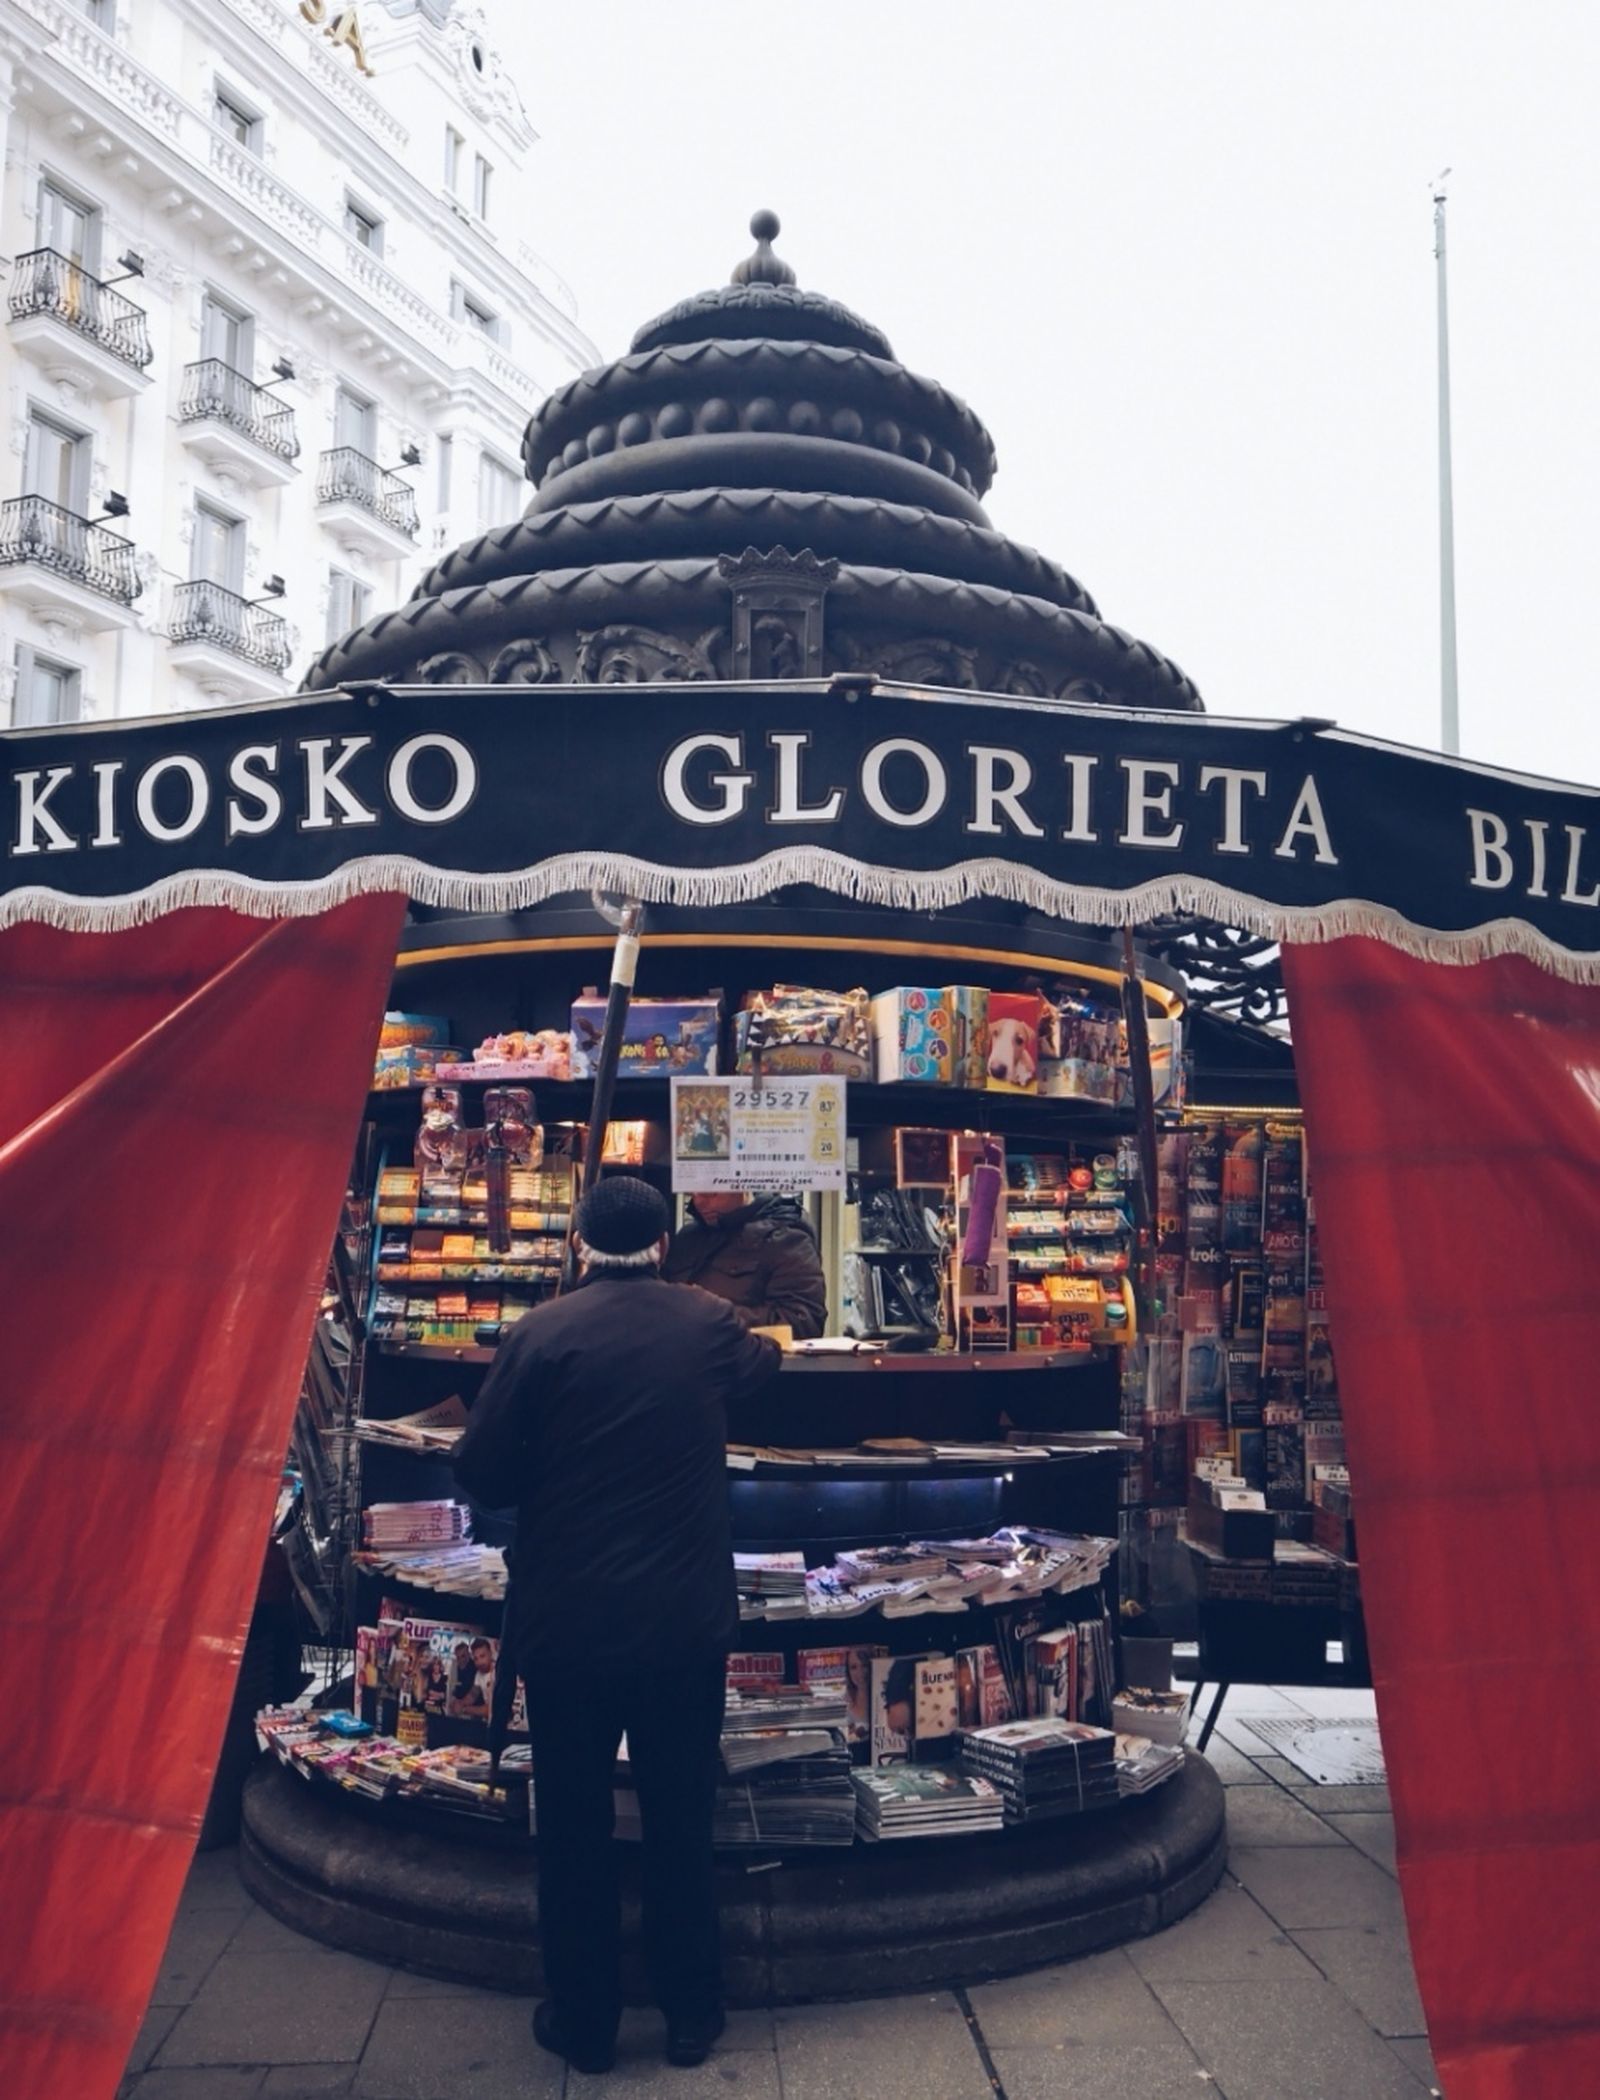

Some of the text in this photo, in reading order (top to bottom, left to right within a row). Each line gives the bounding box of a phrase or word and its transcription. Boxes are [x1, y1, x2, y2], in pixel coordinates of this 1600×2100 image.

[11, 733, 1600, 908] KIOSKO GLORIETA BIL
[734, 1091, 810, 1107] 29527
